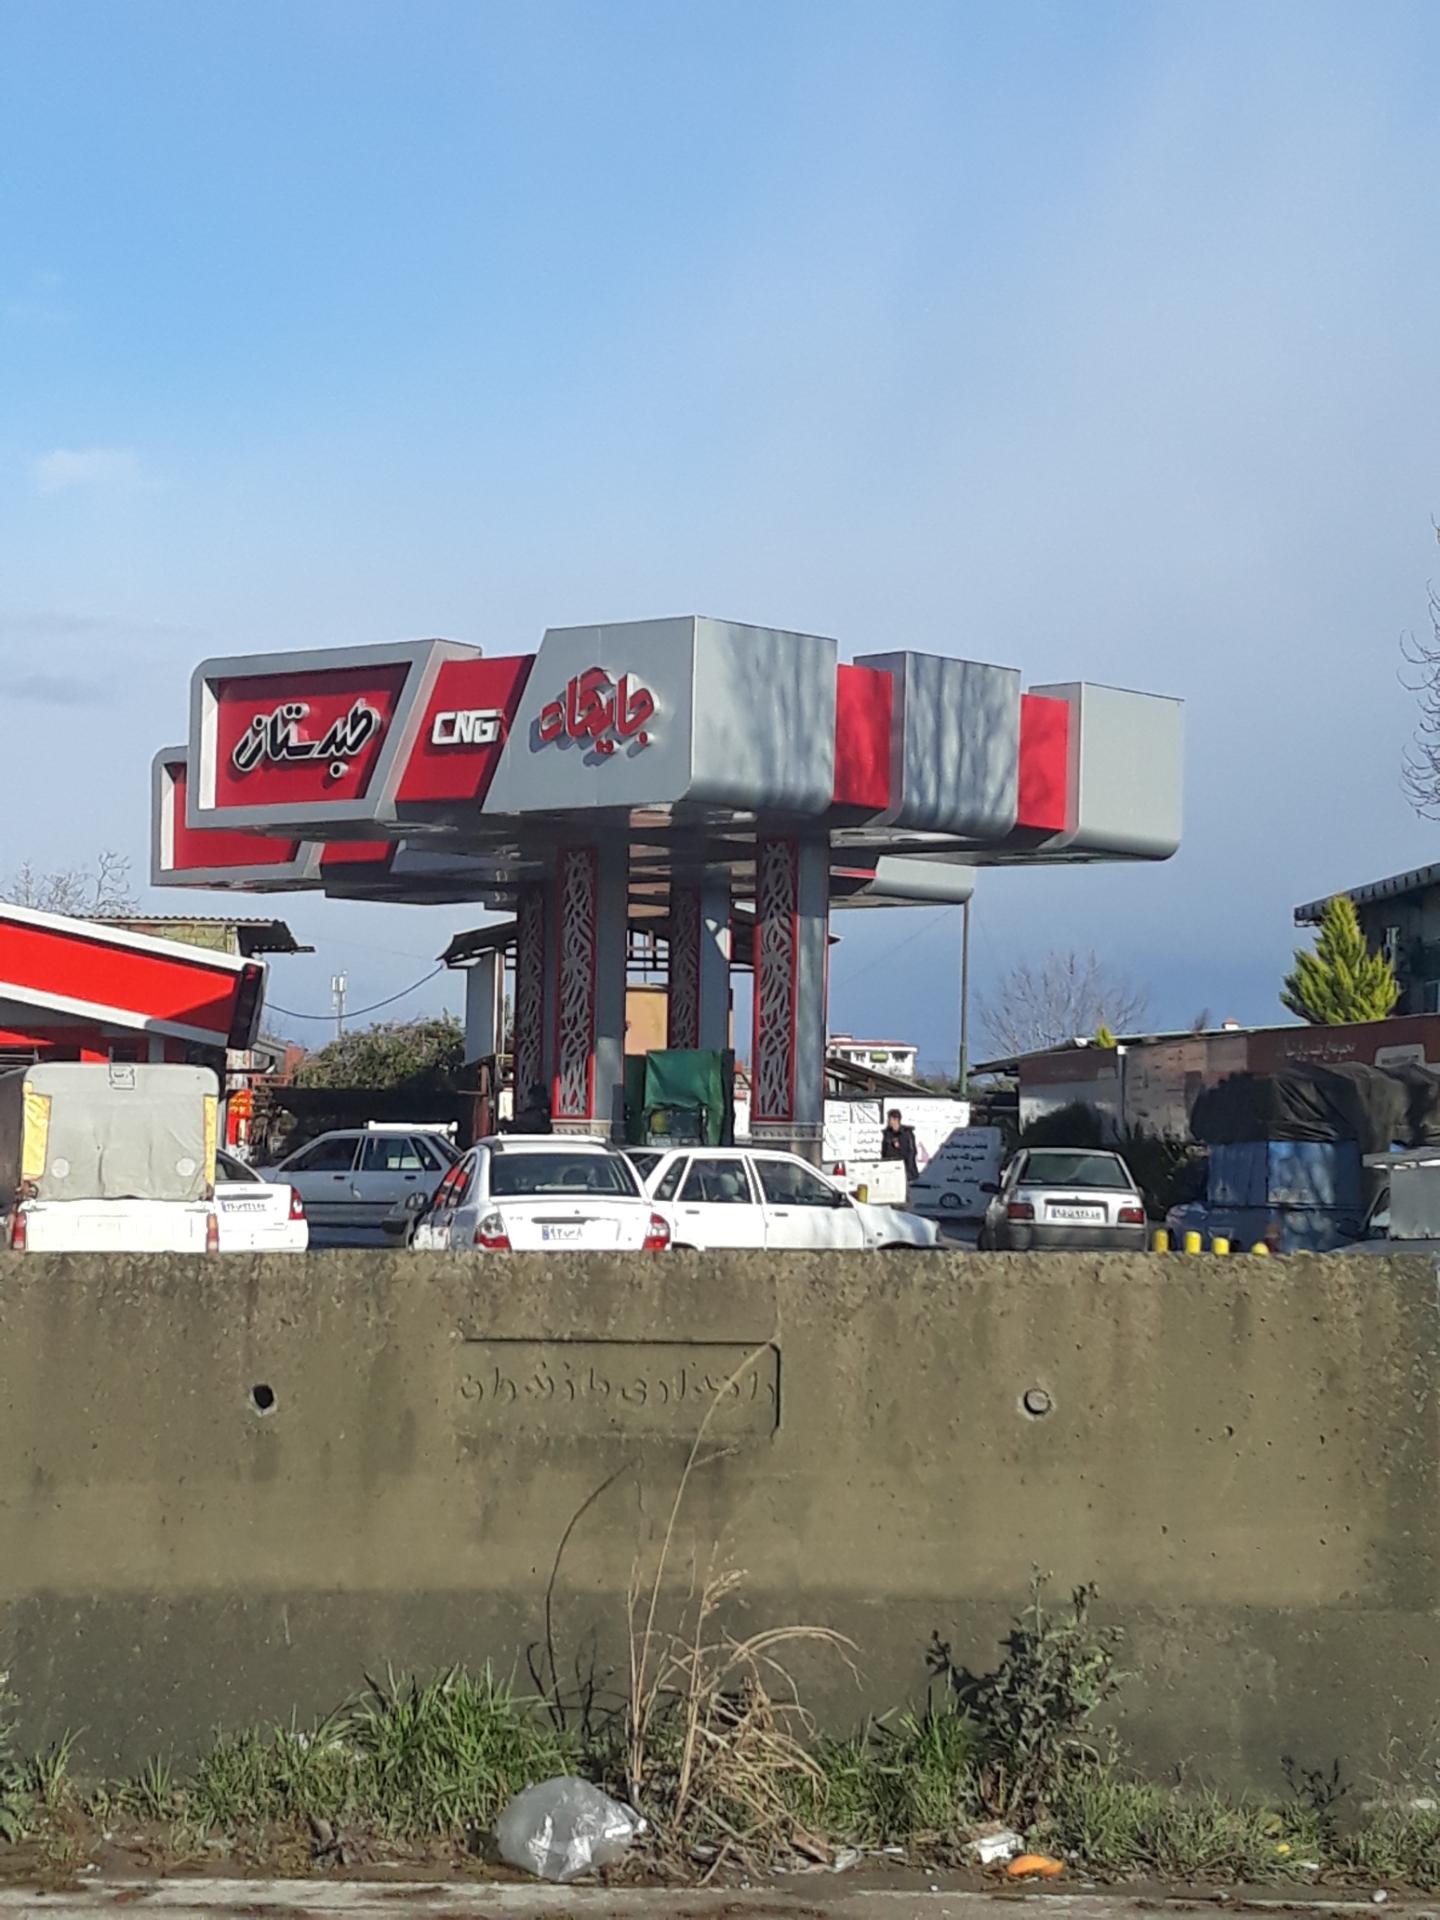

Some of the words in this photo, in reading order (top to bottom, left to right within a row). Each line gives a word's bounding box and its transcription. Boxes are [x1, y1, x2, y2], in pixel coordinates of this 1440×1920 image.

[233, 698, 380, 779] طبرستان
[432, 709, 501, 746] CNG
[538, 667, 655, 755] جایگاه
